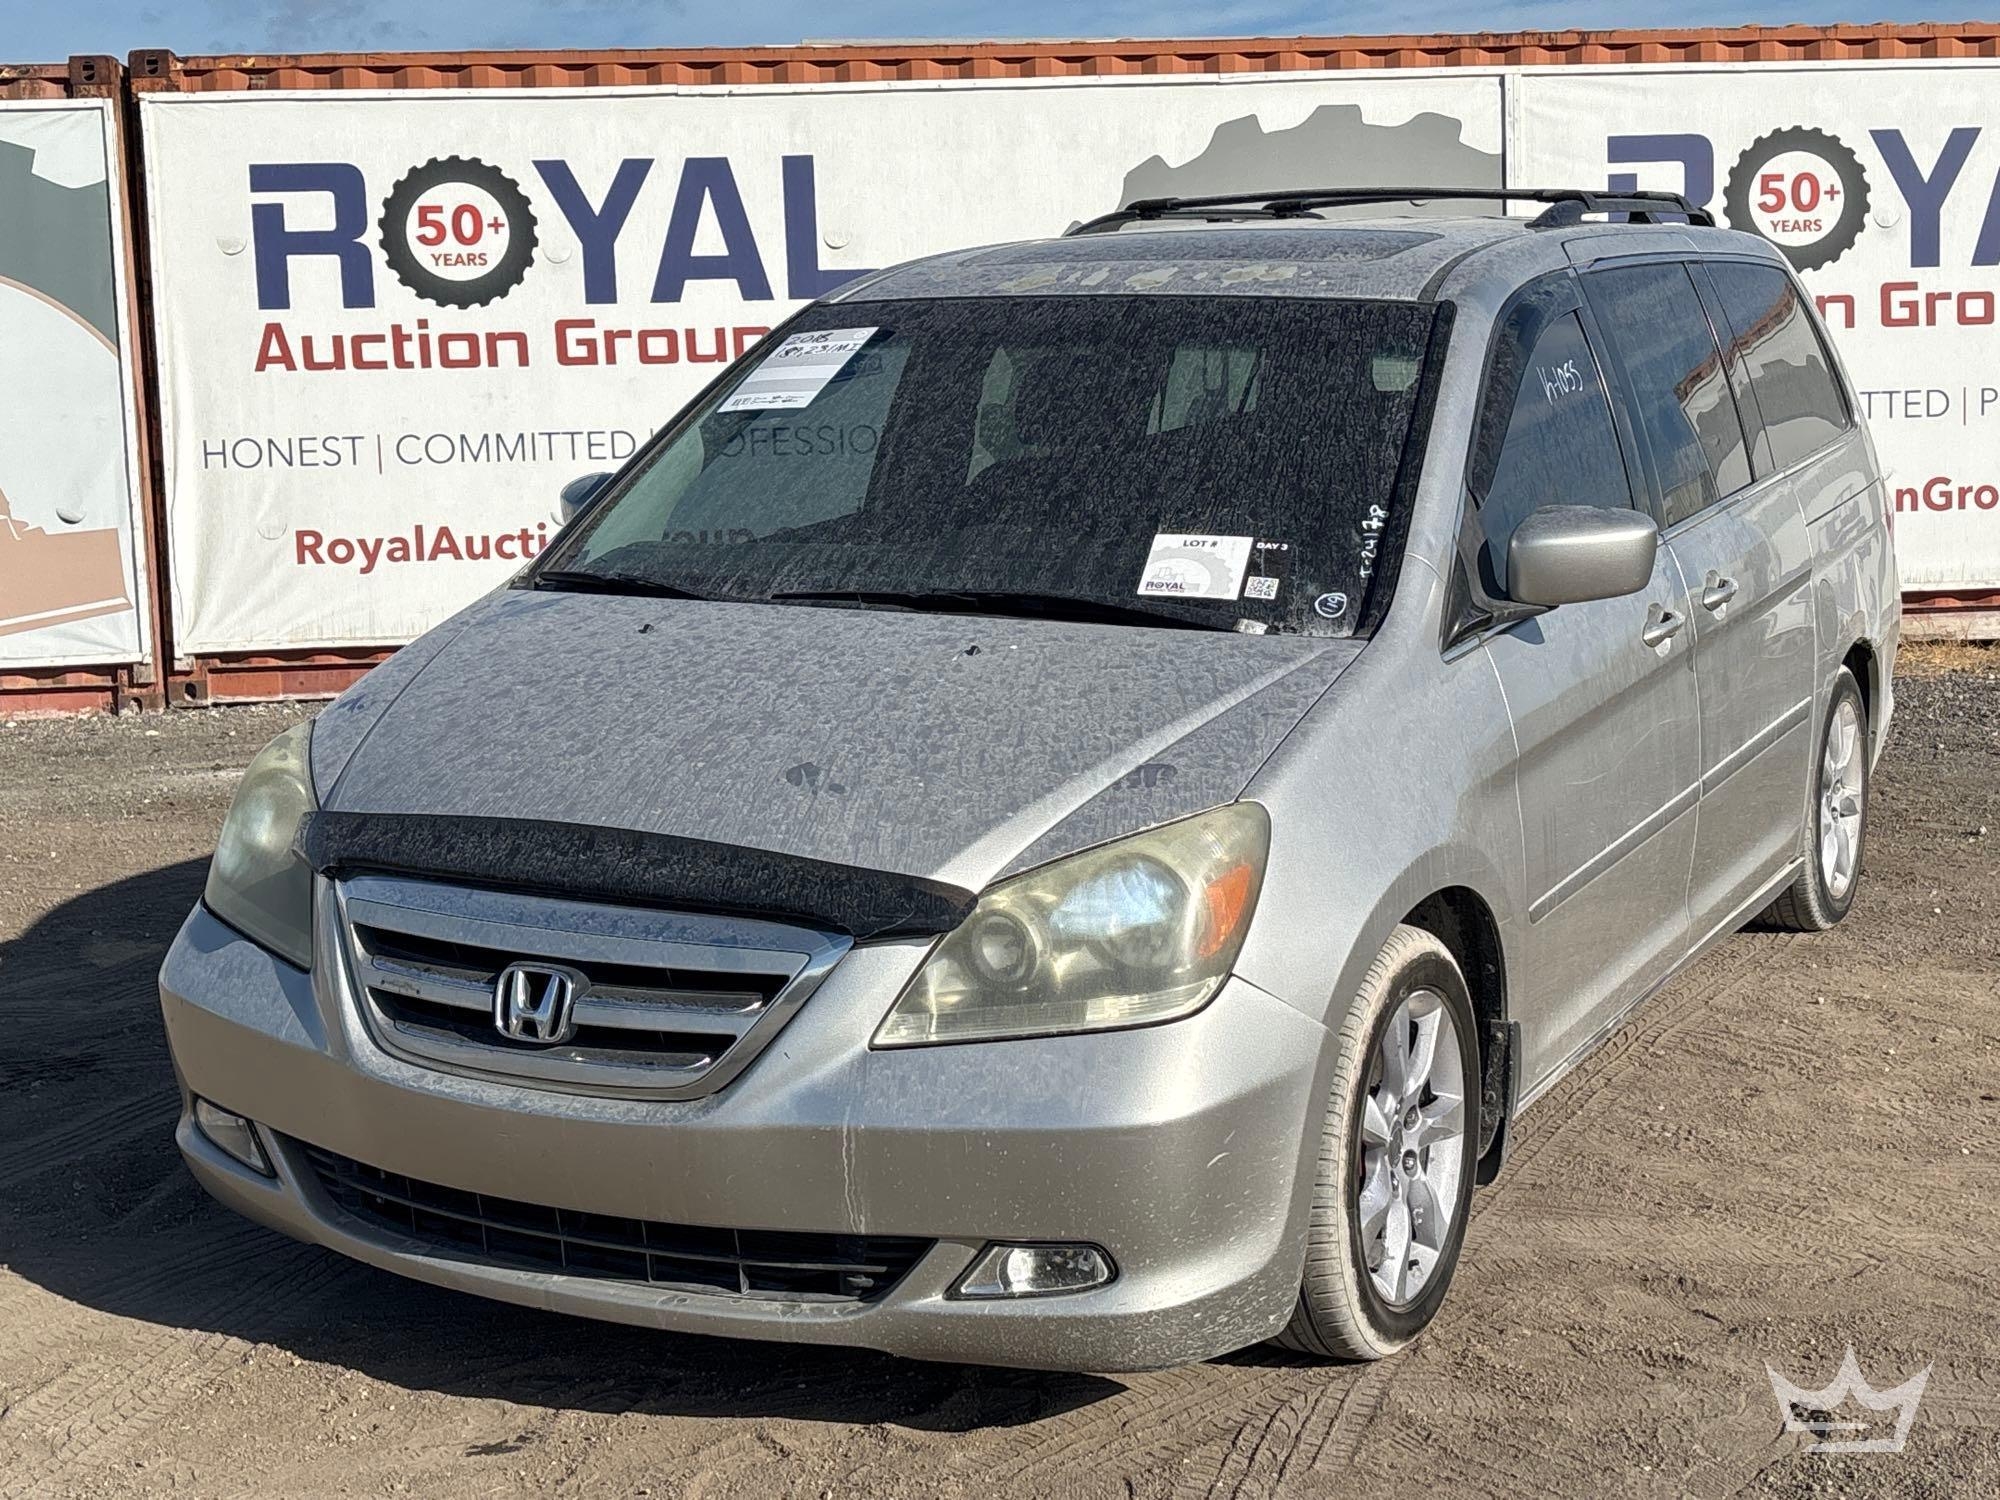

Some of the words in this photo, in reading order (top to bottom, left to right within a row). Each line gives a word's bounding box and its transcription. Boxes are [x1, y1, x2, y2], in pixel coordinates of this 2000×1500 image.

[1607, 125, 2000, 271] ROY
[1758, 172, 1841, 213] 50+
[249, 154, 879, 311] ROYAL
[416, 204, 505, 246] 50+
[1770, 219, 1823, 233] YEARS
[431, 252, 488, 267] YEARS
[255, 320, 530, 373] Auction
[203, 435, 365, 469] HONEST
[396, 430, 637, 464] COMMITTED
[1183, 540, 1208, 548] LOT
[1256, 542, 1280, 550] DAY
[1281, 543, 1289, 551] 3
[1145, 581, 1185, 589] ROYAL
